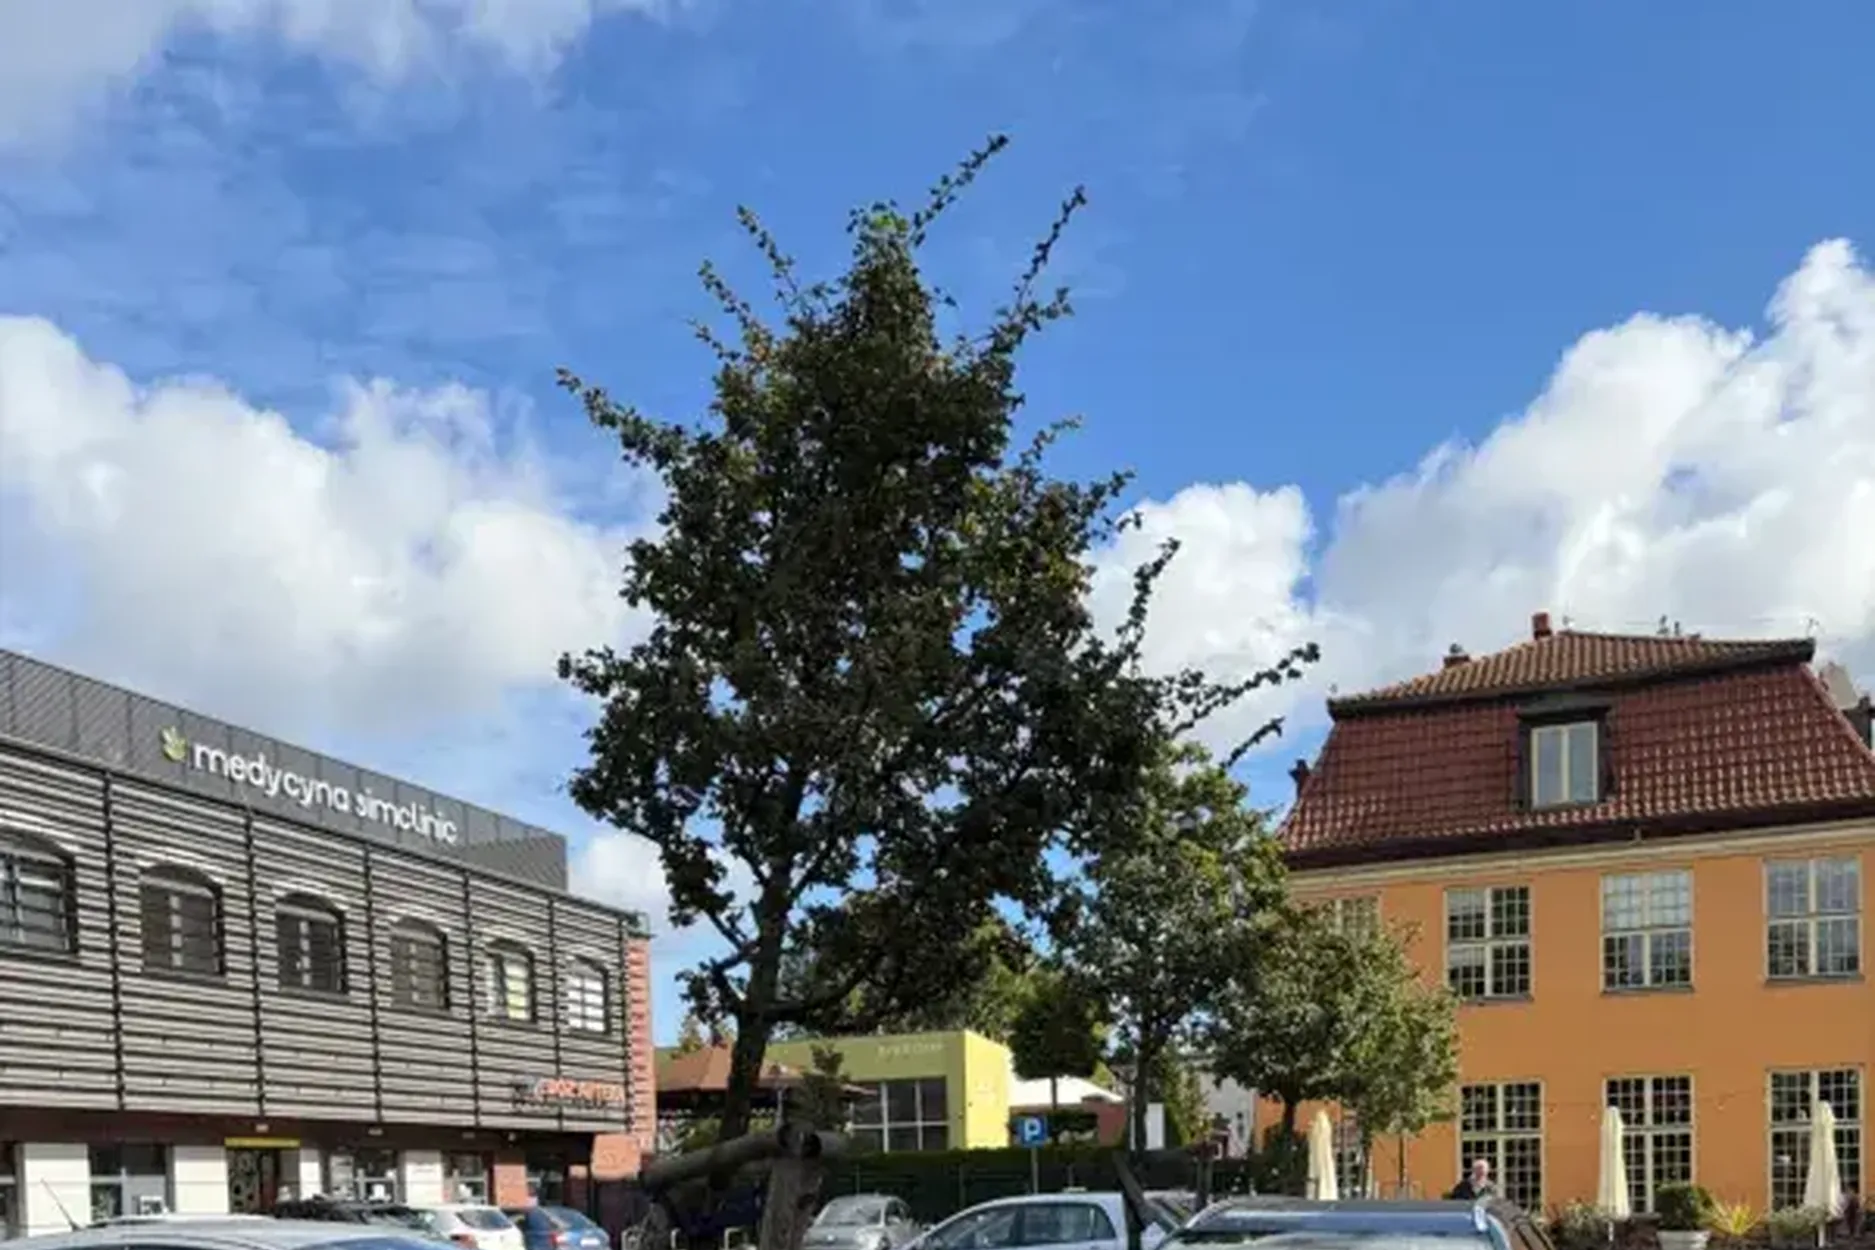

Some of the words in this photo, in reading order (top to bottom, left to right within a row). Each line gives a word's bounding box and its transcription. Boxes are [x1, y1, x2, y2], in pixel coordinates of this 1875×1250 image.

[193, 743, 349, 812] medycyna
[354, 787, 458, 844] simclinic
[1024, 1118, 1041, 1141] P
